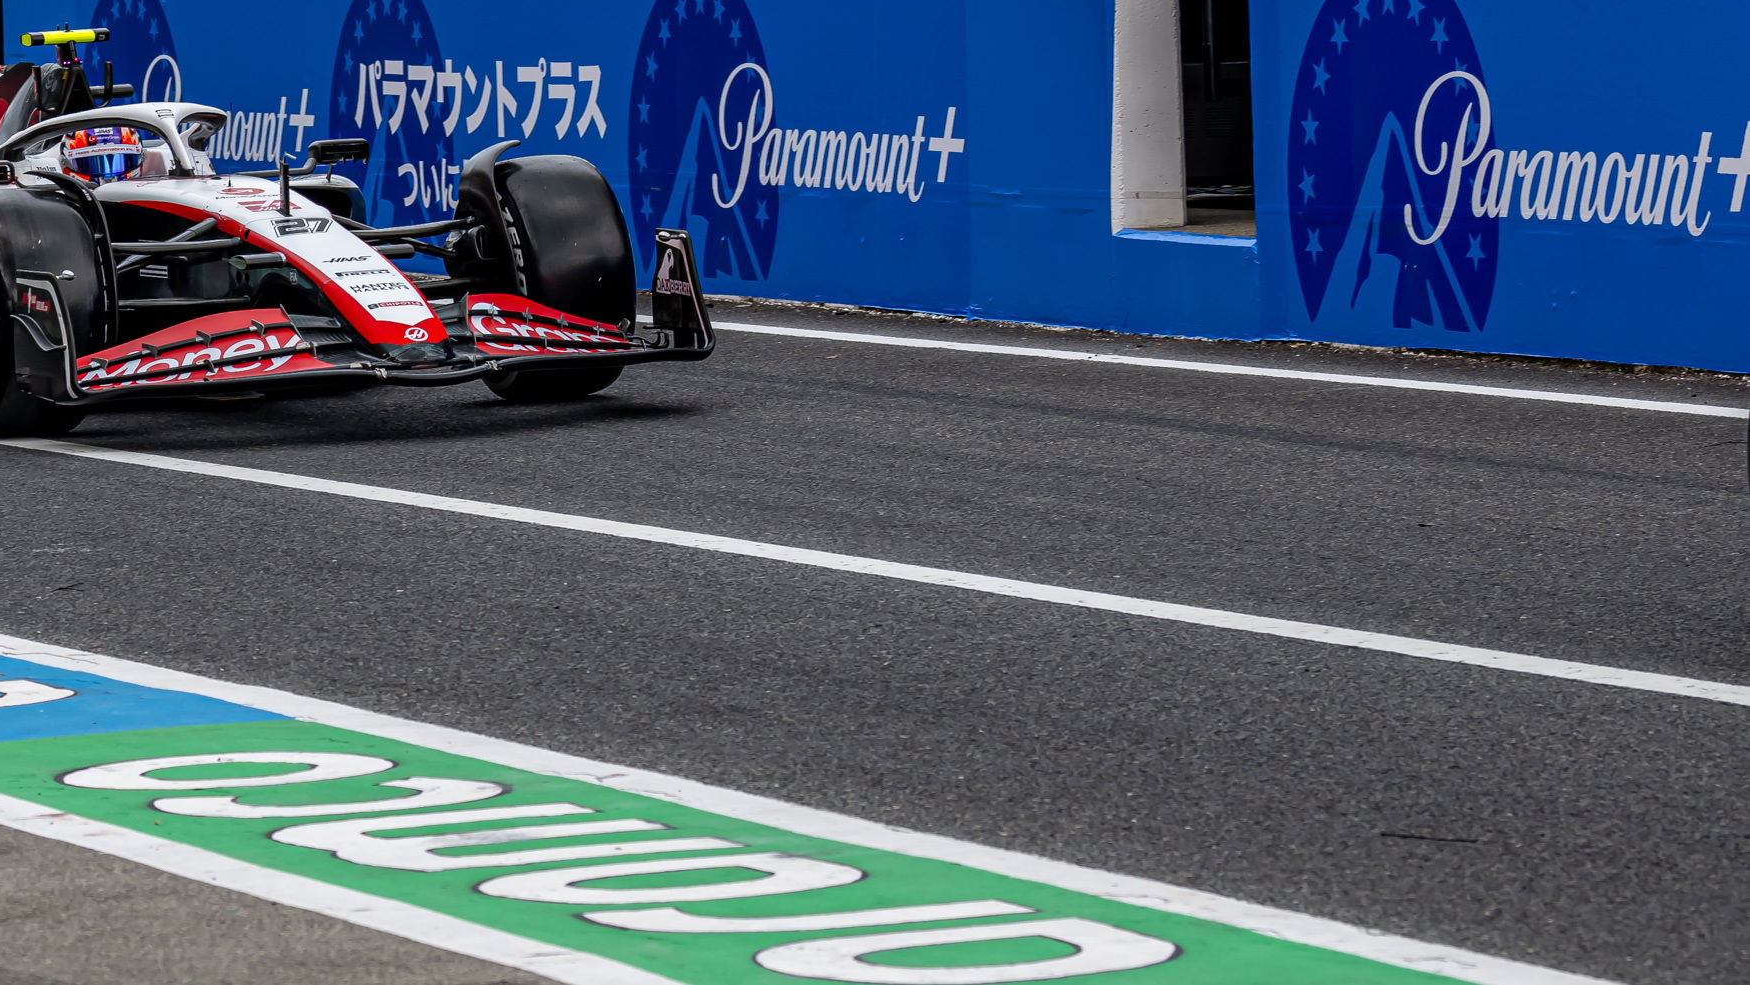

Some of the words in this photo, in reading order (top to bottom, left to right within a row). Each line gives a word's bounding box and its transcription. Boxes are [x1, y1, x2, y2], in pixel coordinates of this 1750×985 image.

[354, 58, 608, 140] パラマウントプラス
[711, 62, 965, 210] Paramount+
[1403, 70, 1750, 247] Paramount+
[271, 216, 334, 238] 27
[322, 255, 372, 264] HAAS
[349, 281, 406, 290] HANTEC
[79, 334, 301, 390] Money
[60, 751, 1178, 985] aramco
